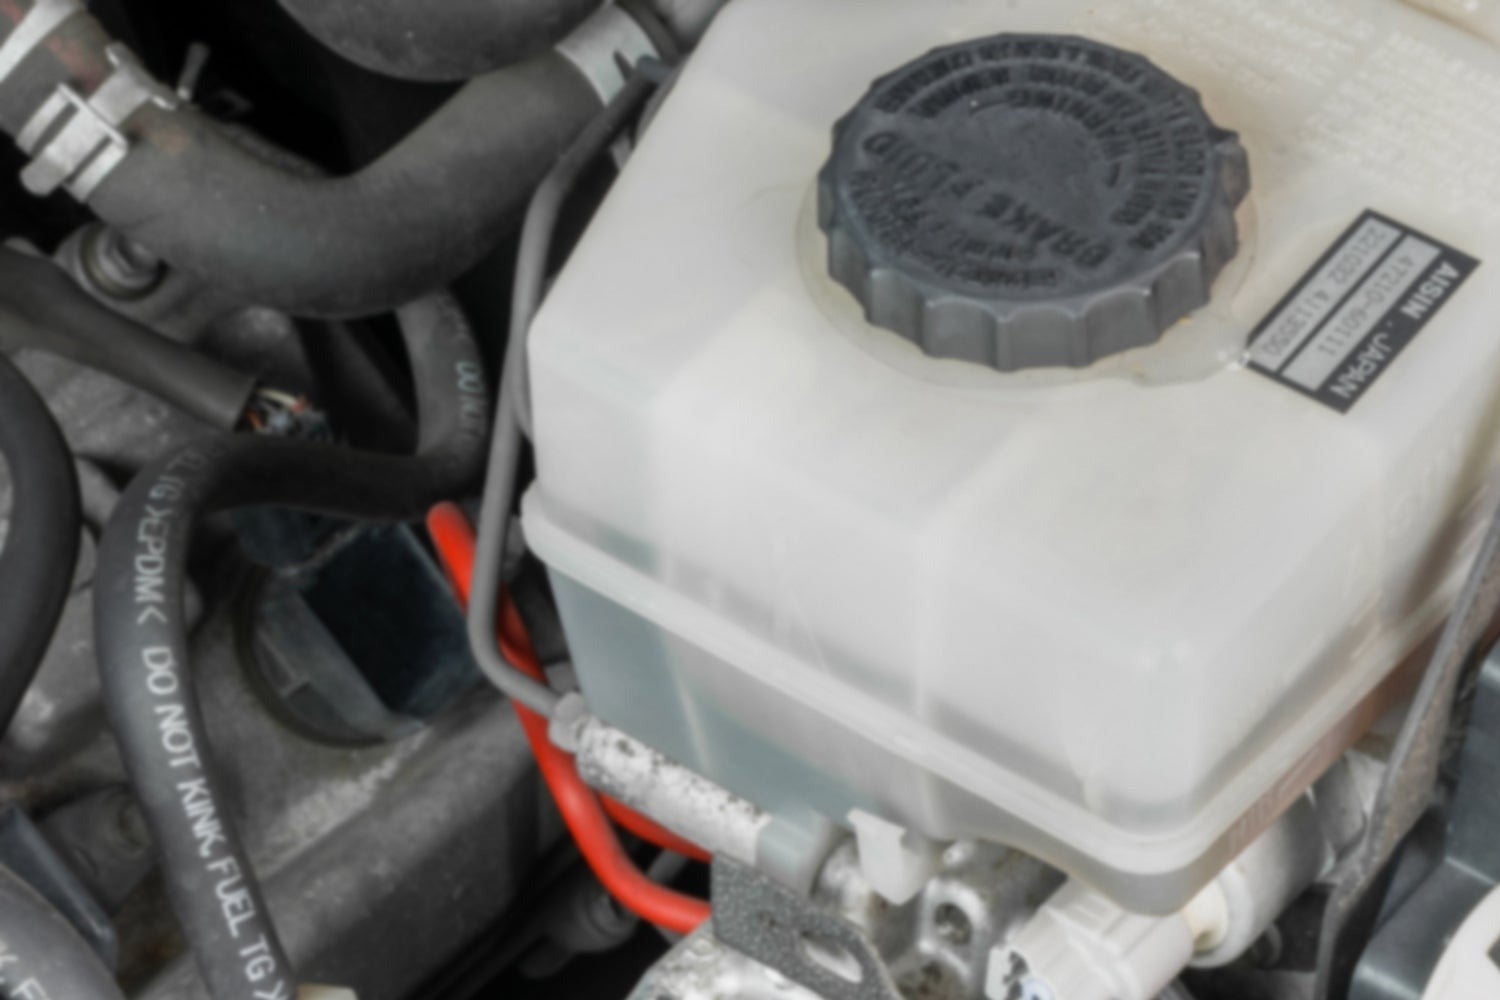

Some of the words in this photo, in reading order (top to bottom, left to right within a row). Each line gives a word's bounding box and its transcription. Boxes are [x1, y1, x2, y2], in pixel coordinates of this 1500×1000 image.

[862, 130, 984, 198] FLUID
[974, 191, 1112, 268] BRAKE
[1400, 260, 1461, 320] AISIN
[1329, 332, 1393, 399] JAPAN
[142, 646, 178, 695] DO
[154, 703, 201, 768] NOT
[207, 856, 256, 938] FUEL
[239, 933, 275, 982] TG
